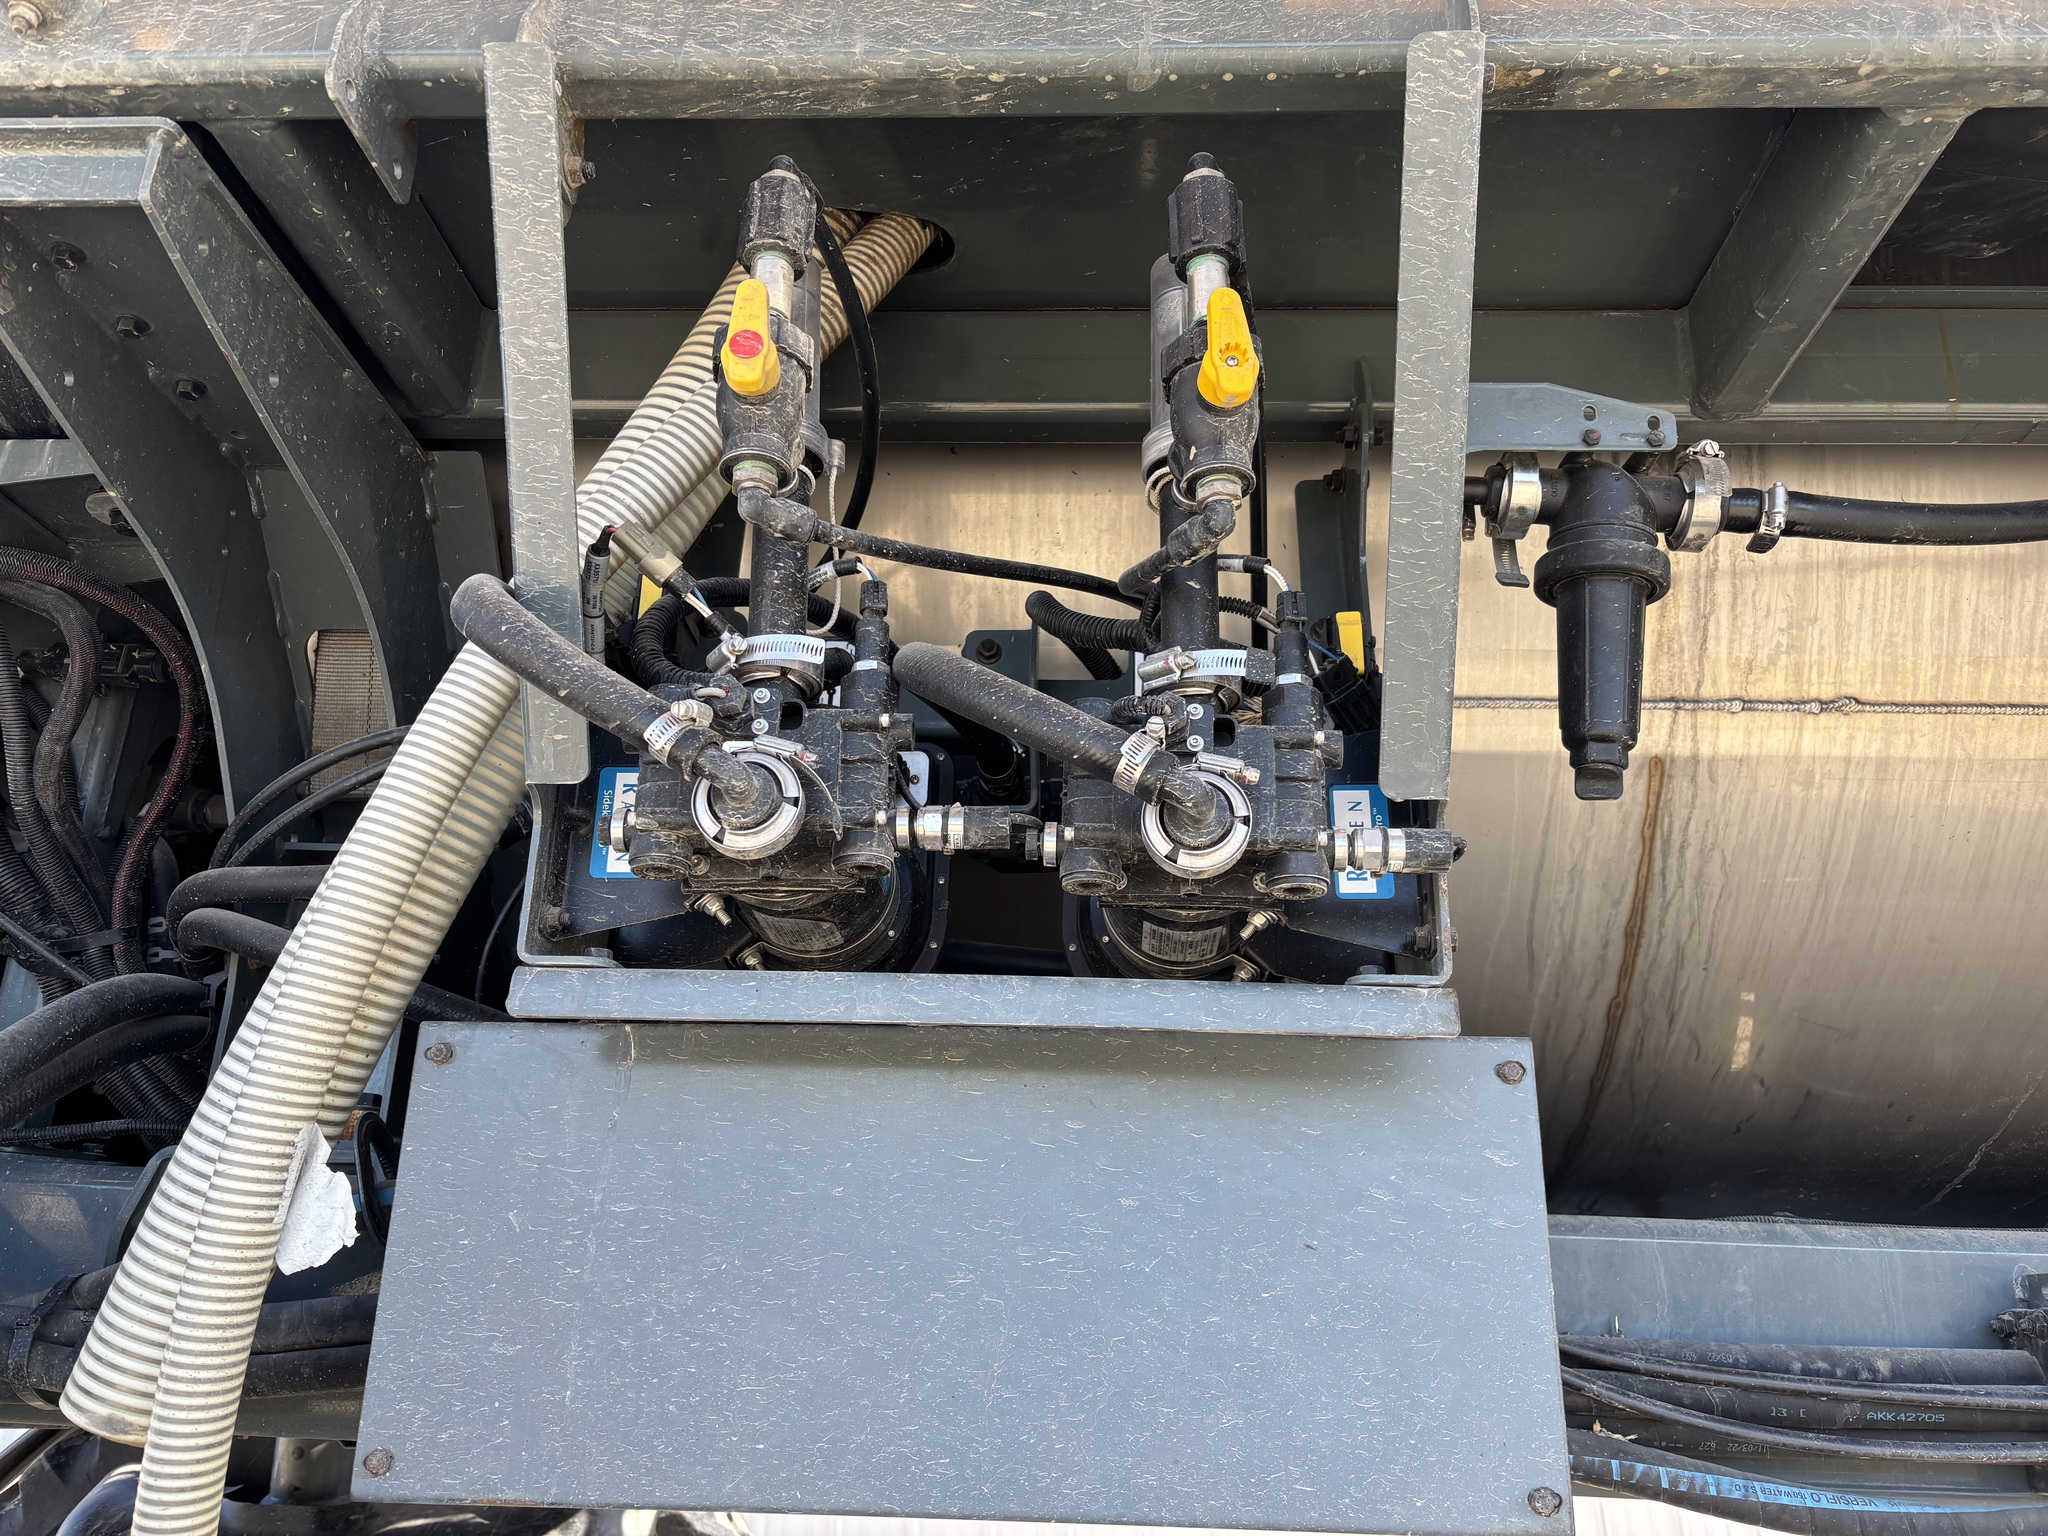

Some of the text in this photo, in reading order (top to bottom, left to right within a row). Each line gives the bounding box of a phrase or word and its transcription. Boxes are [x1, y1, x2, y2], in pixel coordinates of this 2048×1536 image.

[615, 783, 639, 862] RAN
[1346, 801, 1369, 882] REN
[1866, 1411, 1946, 1423] AKK42705
[1698, 1441, 1767, 1453] 11/03/22 627
[1759, 1486, 1793, 1498] WATER
[1810, 1491, 1878, 1507] VERSIFLO
